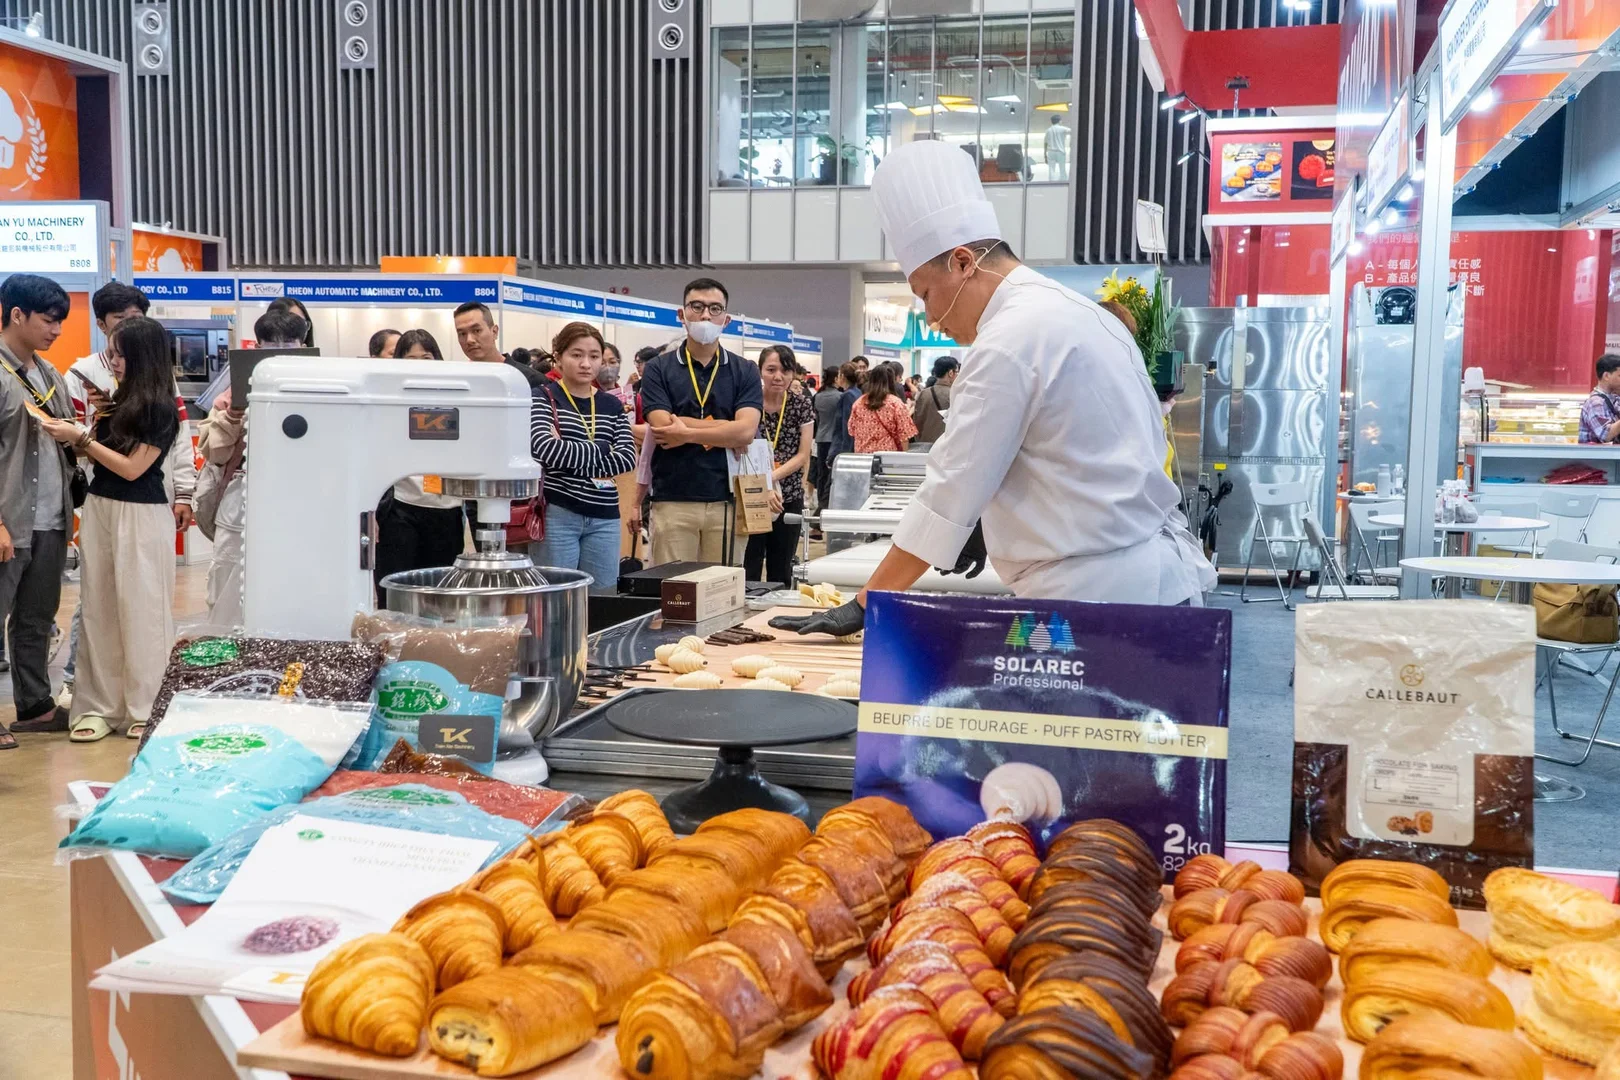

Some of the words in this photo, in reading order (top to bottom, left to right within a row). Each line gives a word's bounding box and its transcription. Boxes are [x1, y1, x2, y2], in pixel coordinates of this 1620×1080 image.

[13, 217, 25, 227] YU
[28, 217, 85, 227] MACHINERY
[15, 231, 34, 242] CO.,
[36, 231, 55, 241] LTD.
[70, 259, 92, 268] B808
[1365, 260, 1375, 270] A
[1365, 273, 1374, 283] B
[136, 285, 156, 295] OGY
[173, 286, 188, 294] LTD
[211, 285, 232, 295] B815
[286, 286, 313, 296] RHEON
[315, 286, 359, 296] AUTOMATIC
[360, 287, 406, 296] MACHINERY
[407, 288, 424, 298] CO.,
[425, 288, 443, 297] LTD.
[474, 287, 496, 296] B804
[993, 656, 1085, 676] SOLAREC
[993, 672, 1084, 690] Professional
[1365, 688, 1458, 704] CALLEBAUT
[873, 712, 931, 727] BEURRE
[935, 716, 954, 730] DE
[959, 718, 1029, 734] TOURAGE
[1042, 724, 1080, 738] PUFF
[1084, 727, 1142, 743] PASTRY
[1163, 855, 1190, 872] 82
